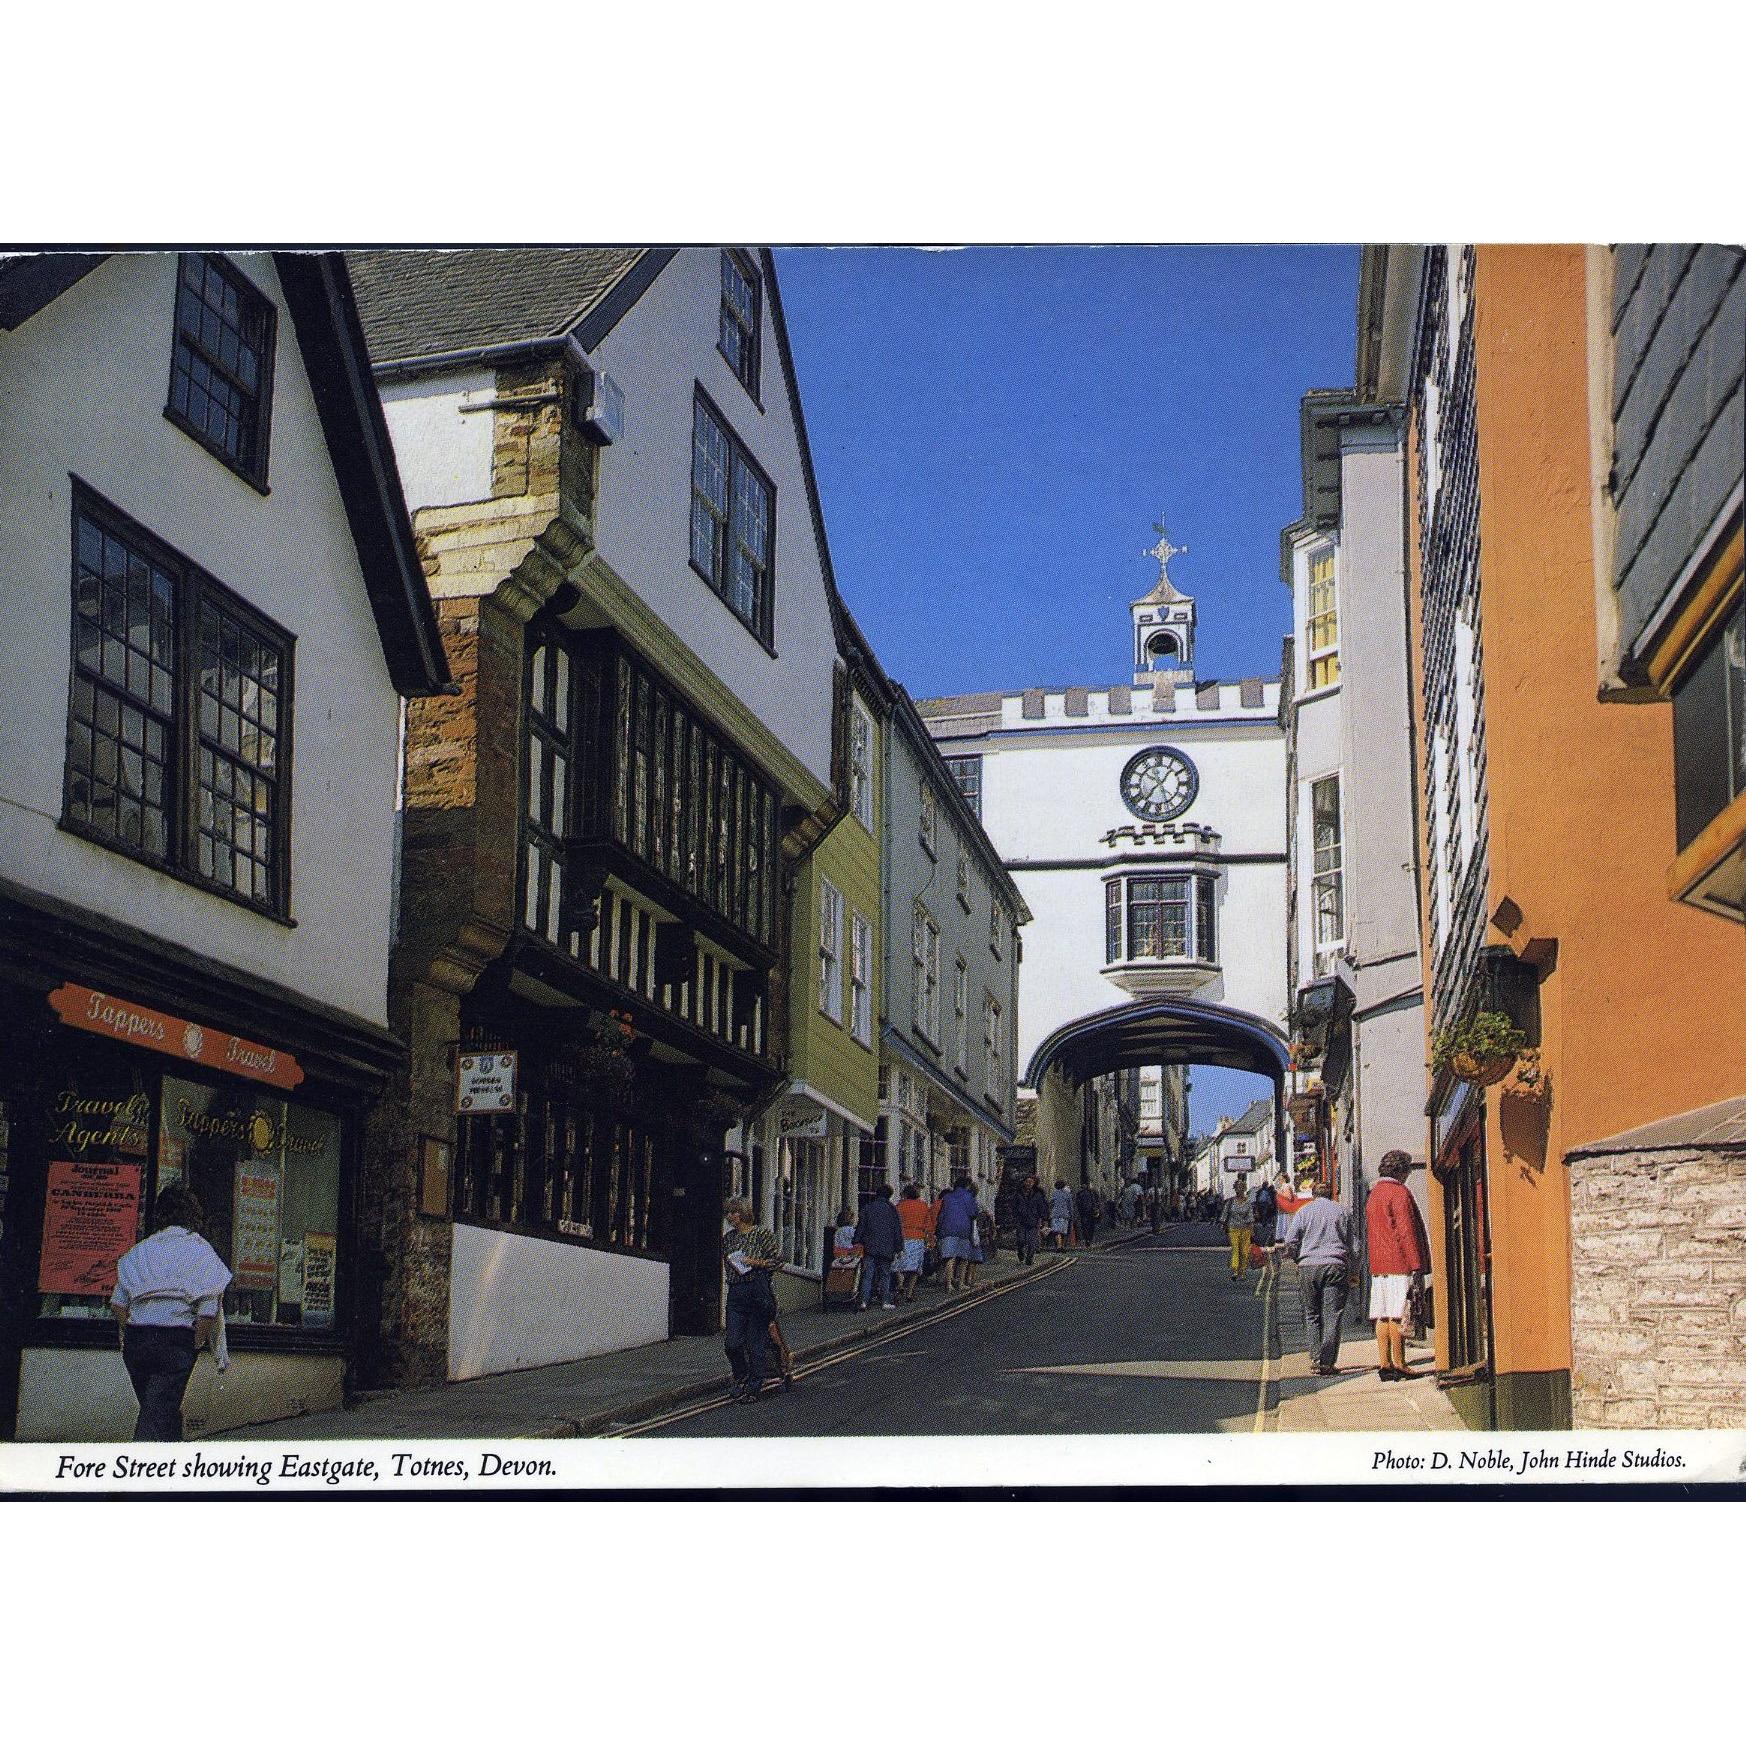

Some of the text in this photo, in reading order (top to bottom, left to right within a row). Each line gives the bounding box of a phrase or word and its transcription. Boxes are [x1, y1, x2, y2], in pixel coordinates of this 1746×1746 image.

[87, 992, 277, 1074] Tappers Travel
[55, 1089, 139, 1115] Travel
[176, 1097, 245, 1140] Tappers
[50, 1120, 139, 1152] Agents
[51, 1188, 135, 1200] CANBERRA
